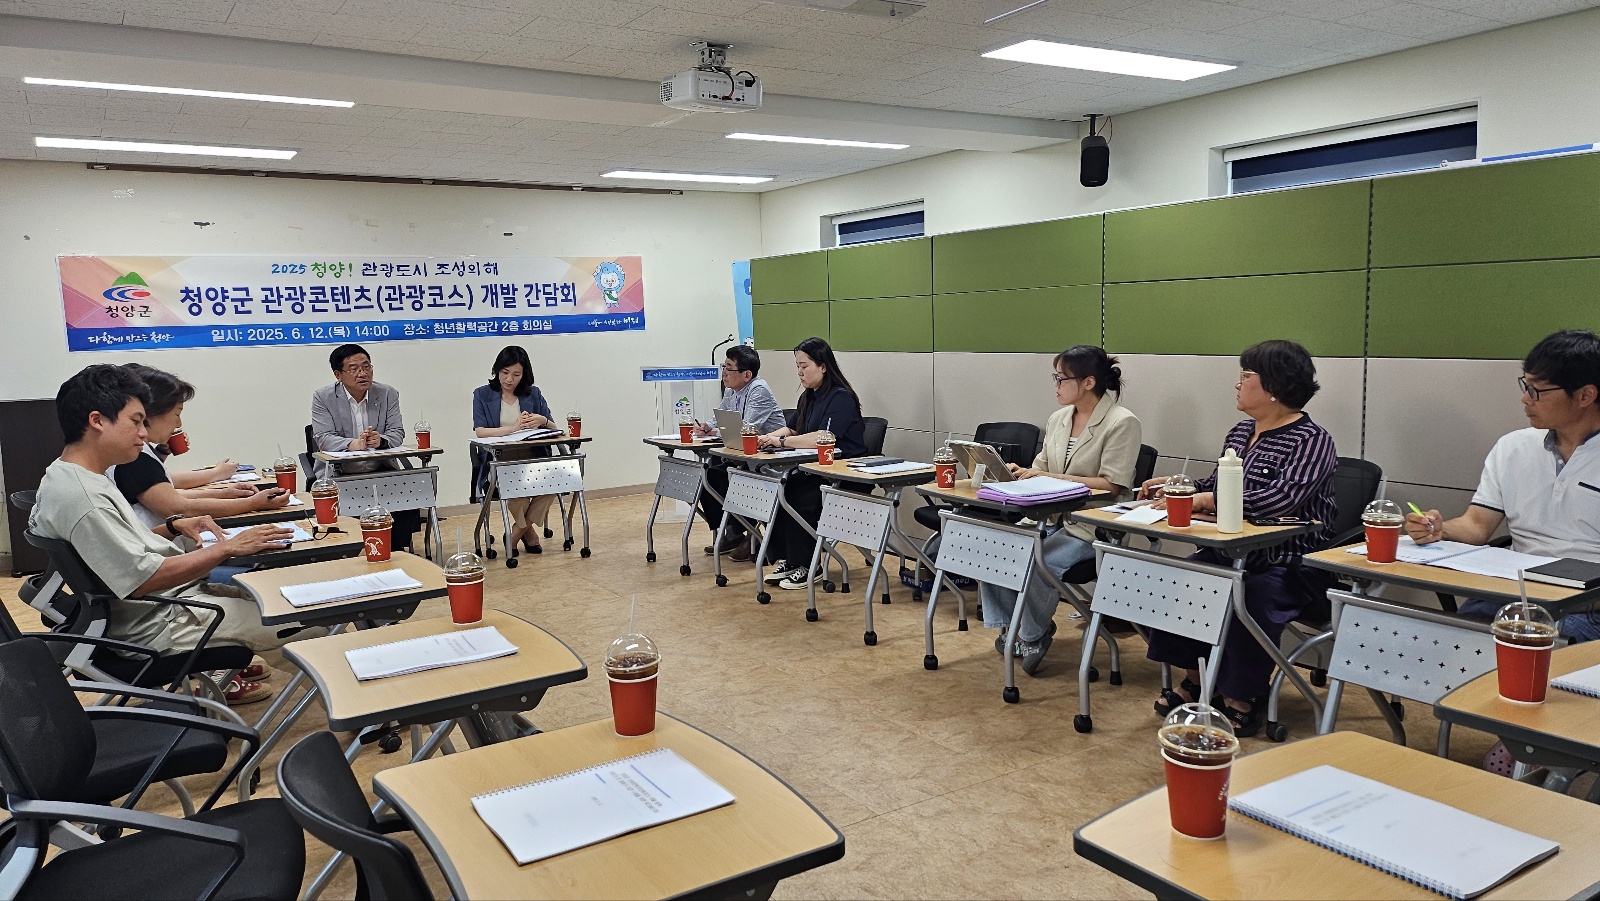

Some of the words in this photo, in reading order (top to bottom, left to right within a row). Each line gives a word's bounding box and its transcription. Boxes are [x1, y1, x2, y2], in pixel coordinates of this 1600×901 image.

[271, 263, 307, 275] 2025
[311, 261, 353, 279] 청양!
[361, 261, 428, 278] 관광도시
[434, 261, 499, 277] 조성의해
[179, 286, 254, 317] 청양군
[260, 282, 474, 315] 관광콘텐츠(관광코스)
[480, 283, 519, 310] 개발
[524, 281, 578, 309] 간담회
[105, 305, 152, 319] 청양군
[211, 329, 244, 342] 일시:
[247, 328, 288, 341] 2025.
[291, 327, 305, 339] 6.
[309, 326, 351, 339] 12.(목)
[354, 324, 390, 337] 14:00
[403, 322, 430, 336] 장소:
[433, 320, 499, 335] 청년활력공간
[501, 320, 520, 332] 2층
[522, 319, 553, 331] 회의실
